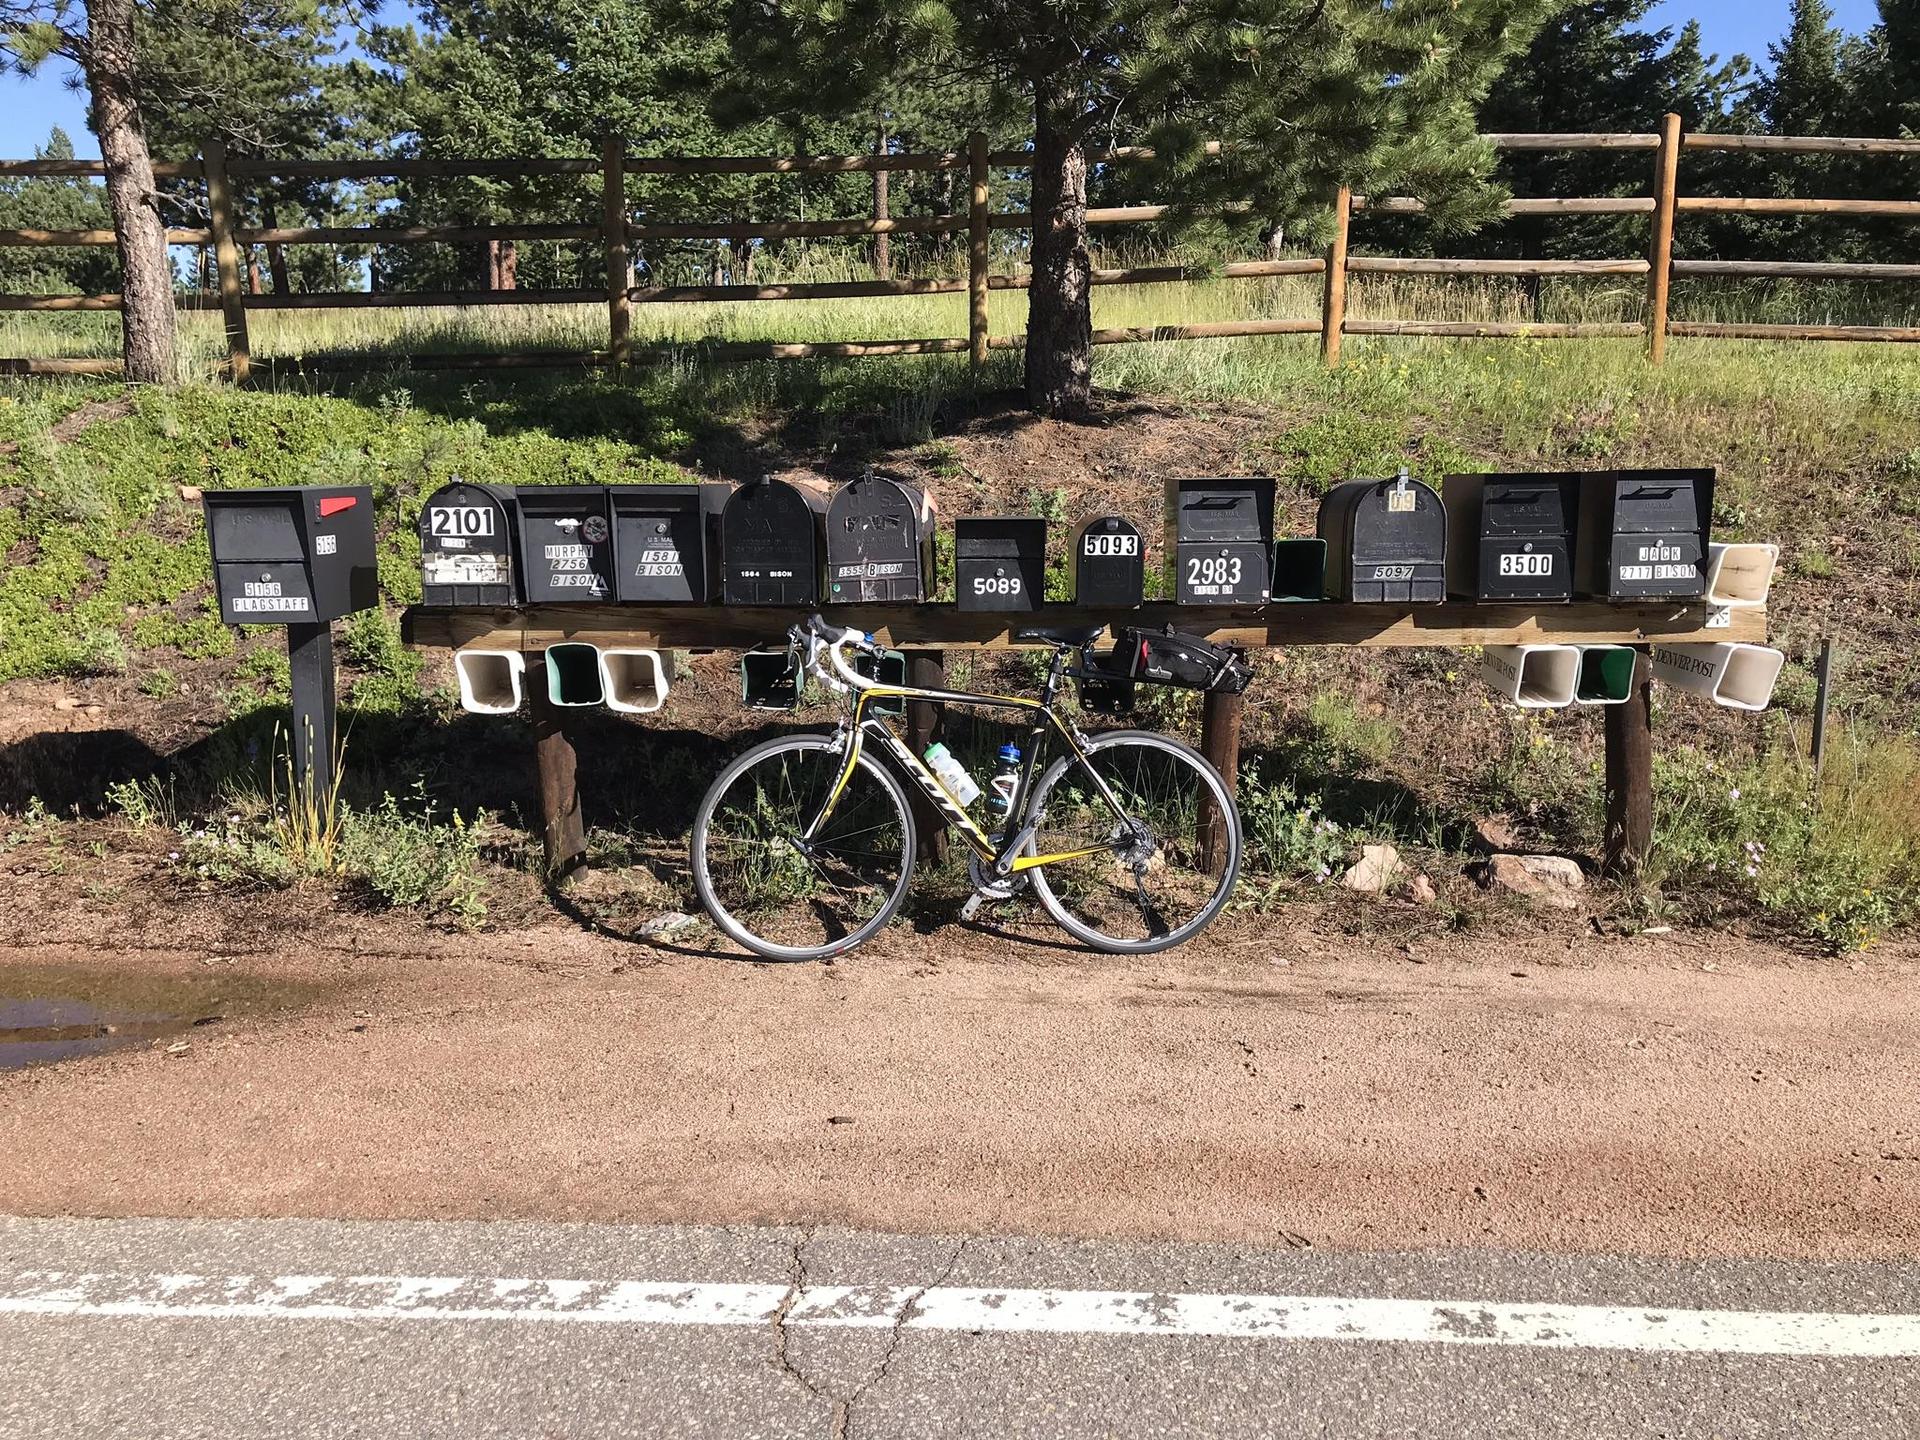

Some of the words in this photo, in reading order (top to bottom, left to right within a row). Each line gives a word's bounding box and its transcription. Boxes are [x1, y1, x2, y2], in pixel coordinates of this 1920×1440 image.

[433, 508, 493, 535] 2101
[545, 545, 593, 558] MURPHY
[1086, 535, 1136, 555] 5093
[645, 551, 678, 562] 1581
[1640, 547, 1680, 561] JACK
[551, 559, 587, 569] 2756
[637, 565, 683, 575] BISON
[869, 564, 902, 576] BISON
[1503, 555, 1551, 574] 3500
[769, 570, 793, 578] BISON
[1187, 557, 1242, 585] 2983
[1375, 567, 1413, 578] 5097
[1621, 566, 1652, 579] 2717
[1656, 565, 1696, 578] BISON
[551, 574, 594, 586] BISON
[973, 577, 1021, 595] 5089
[246, 583, 281, 596] 5156
[234, 598, 308, 611] FLAGSTAFF
[1656, 649, 1691, 671] DENVER
[1690, 658, 1716, 678] POST
[883, 737, 980, 838] SCOTT
